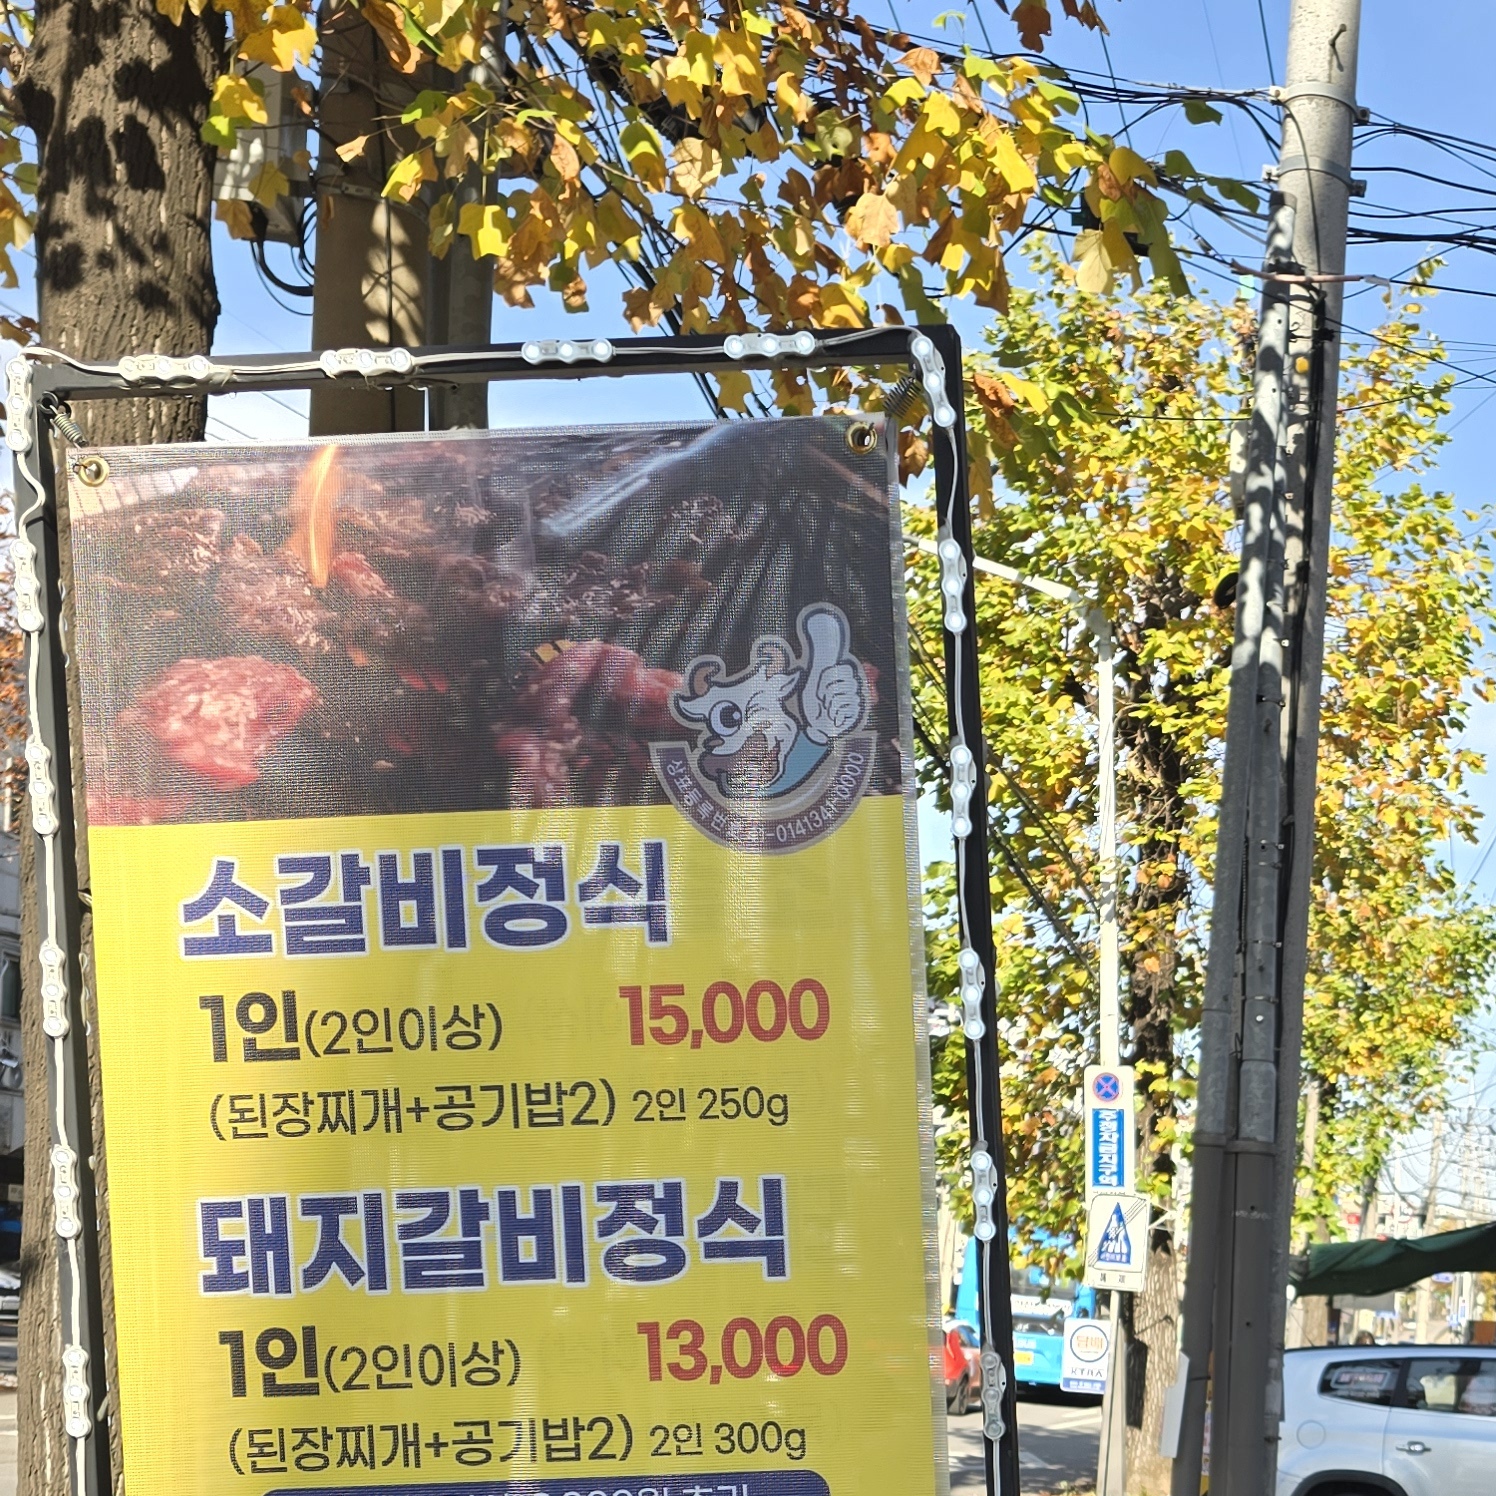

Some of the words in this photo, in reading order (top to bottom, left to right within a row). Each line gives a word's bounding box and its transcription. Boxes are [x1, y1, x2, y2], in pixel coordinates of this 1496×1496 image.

[180, 839, 671, 960] 소갈비정식
[619, 978, 829, 1050] 15,000
[210, 1080, 616, 1142] (된장찌개+공기밥2)
[633, 1090, 688, 1123] 2인
[697, 1086, 789, 1127] 250g
[197, 1175, 788, 1297] 돼지갈비정식
[636, 1314, 848, 1387] 13,000
[229, 1414, 633, 1477] (된장찌개+공기밥2)
[650, 1425, 703, 1459] 2인
[713, 1421, 806, 1462] 300g
